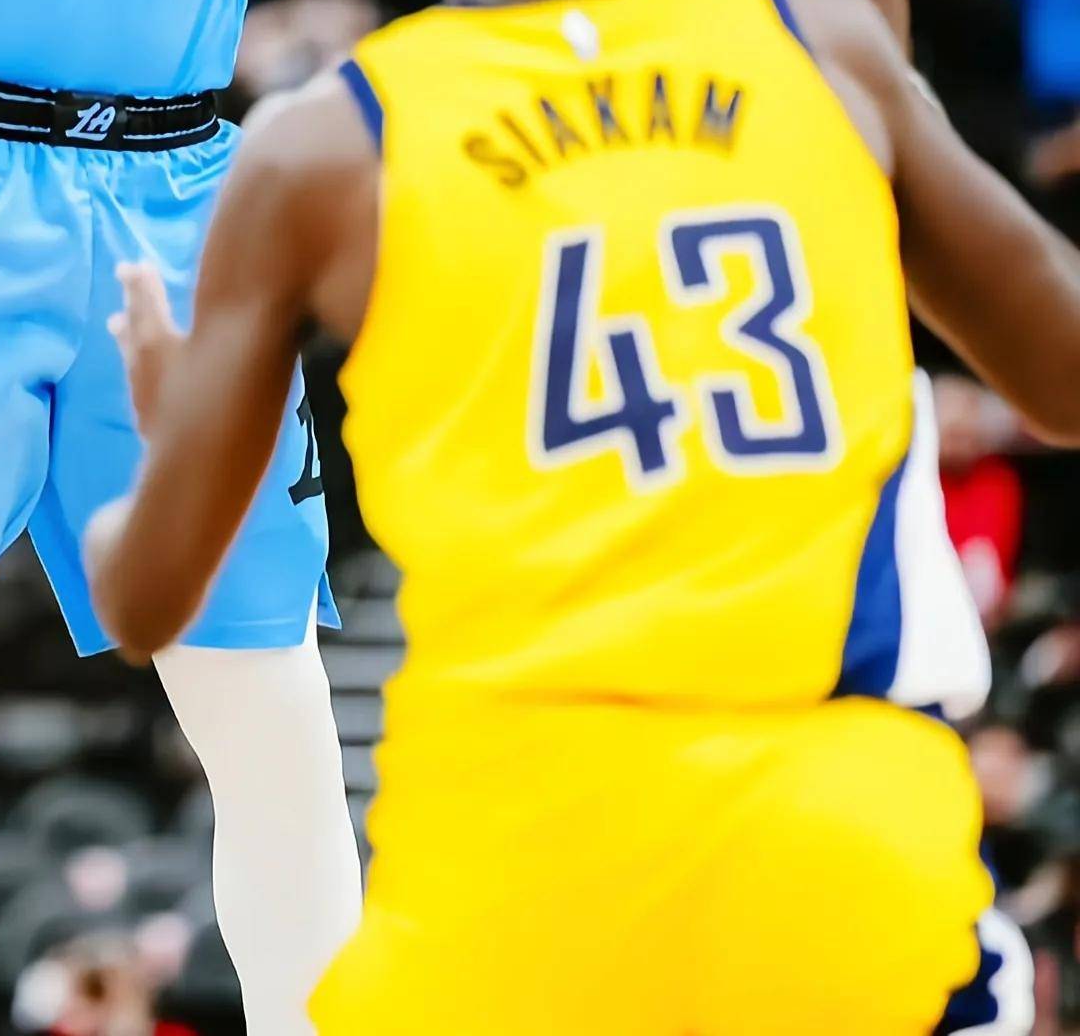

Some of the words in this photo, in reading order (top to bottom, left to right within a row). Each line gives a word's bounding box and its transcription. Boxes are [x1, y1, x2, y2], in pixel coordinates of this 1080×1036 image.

[65, 101, 116, 142] LA
[462, 70, 744, 192] SIAKAM
[530, 208, 838, 486] 43
